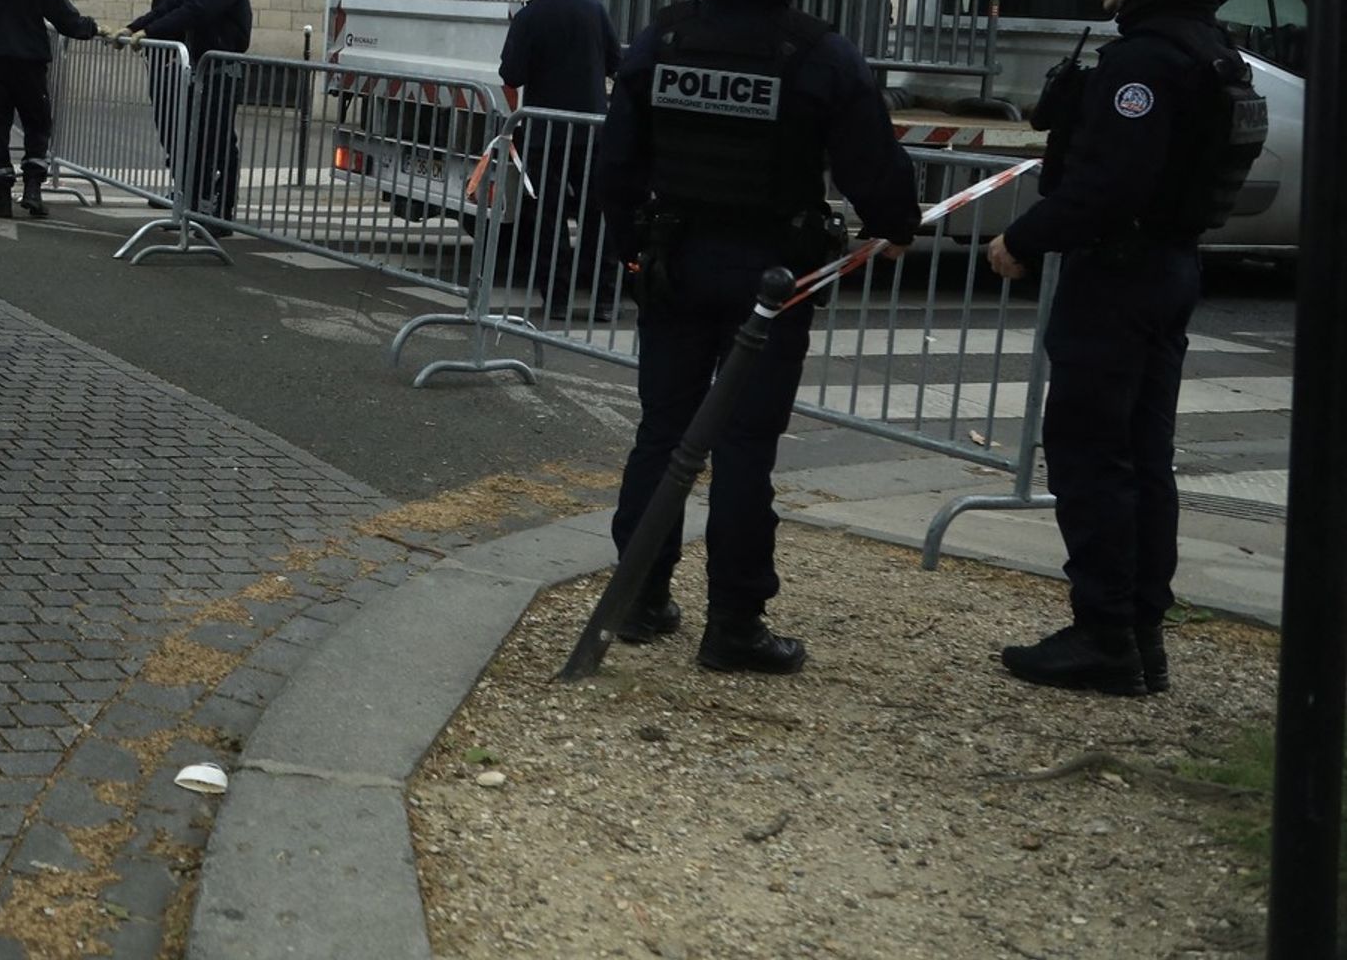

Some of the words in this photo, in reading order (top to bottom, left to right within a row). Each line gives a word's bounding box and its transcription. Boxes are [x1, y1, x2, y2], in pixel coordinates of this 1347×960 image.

[657, 69, 773, 106] POLICE
[657, 96, 702, 108] COMPAGNIE
[705, 103, 770, 116] D'INTERVENTION
